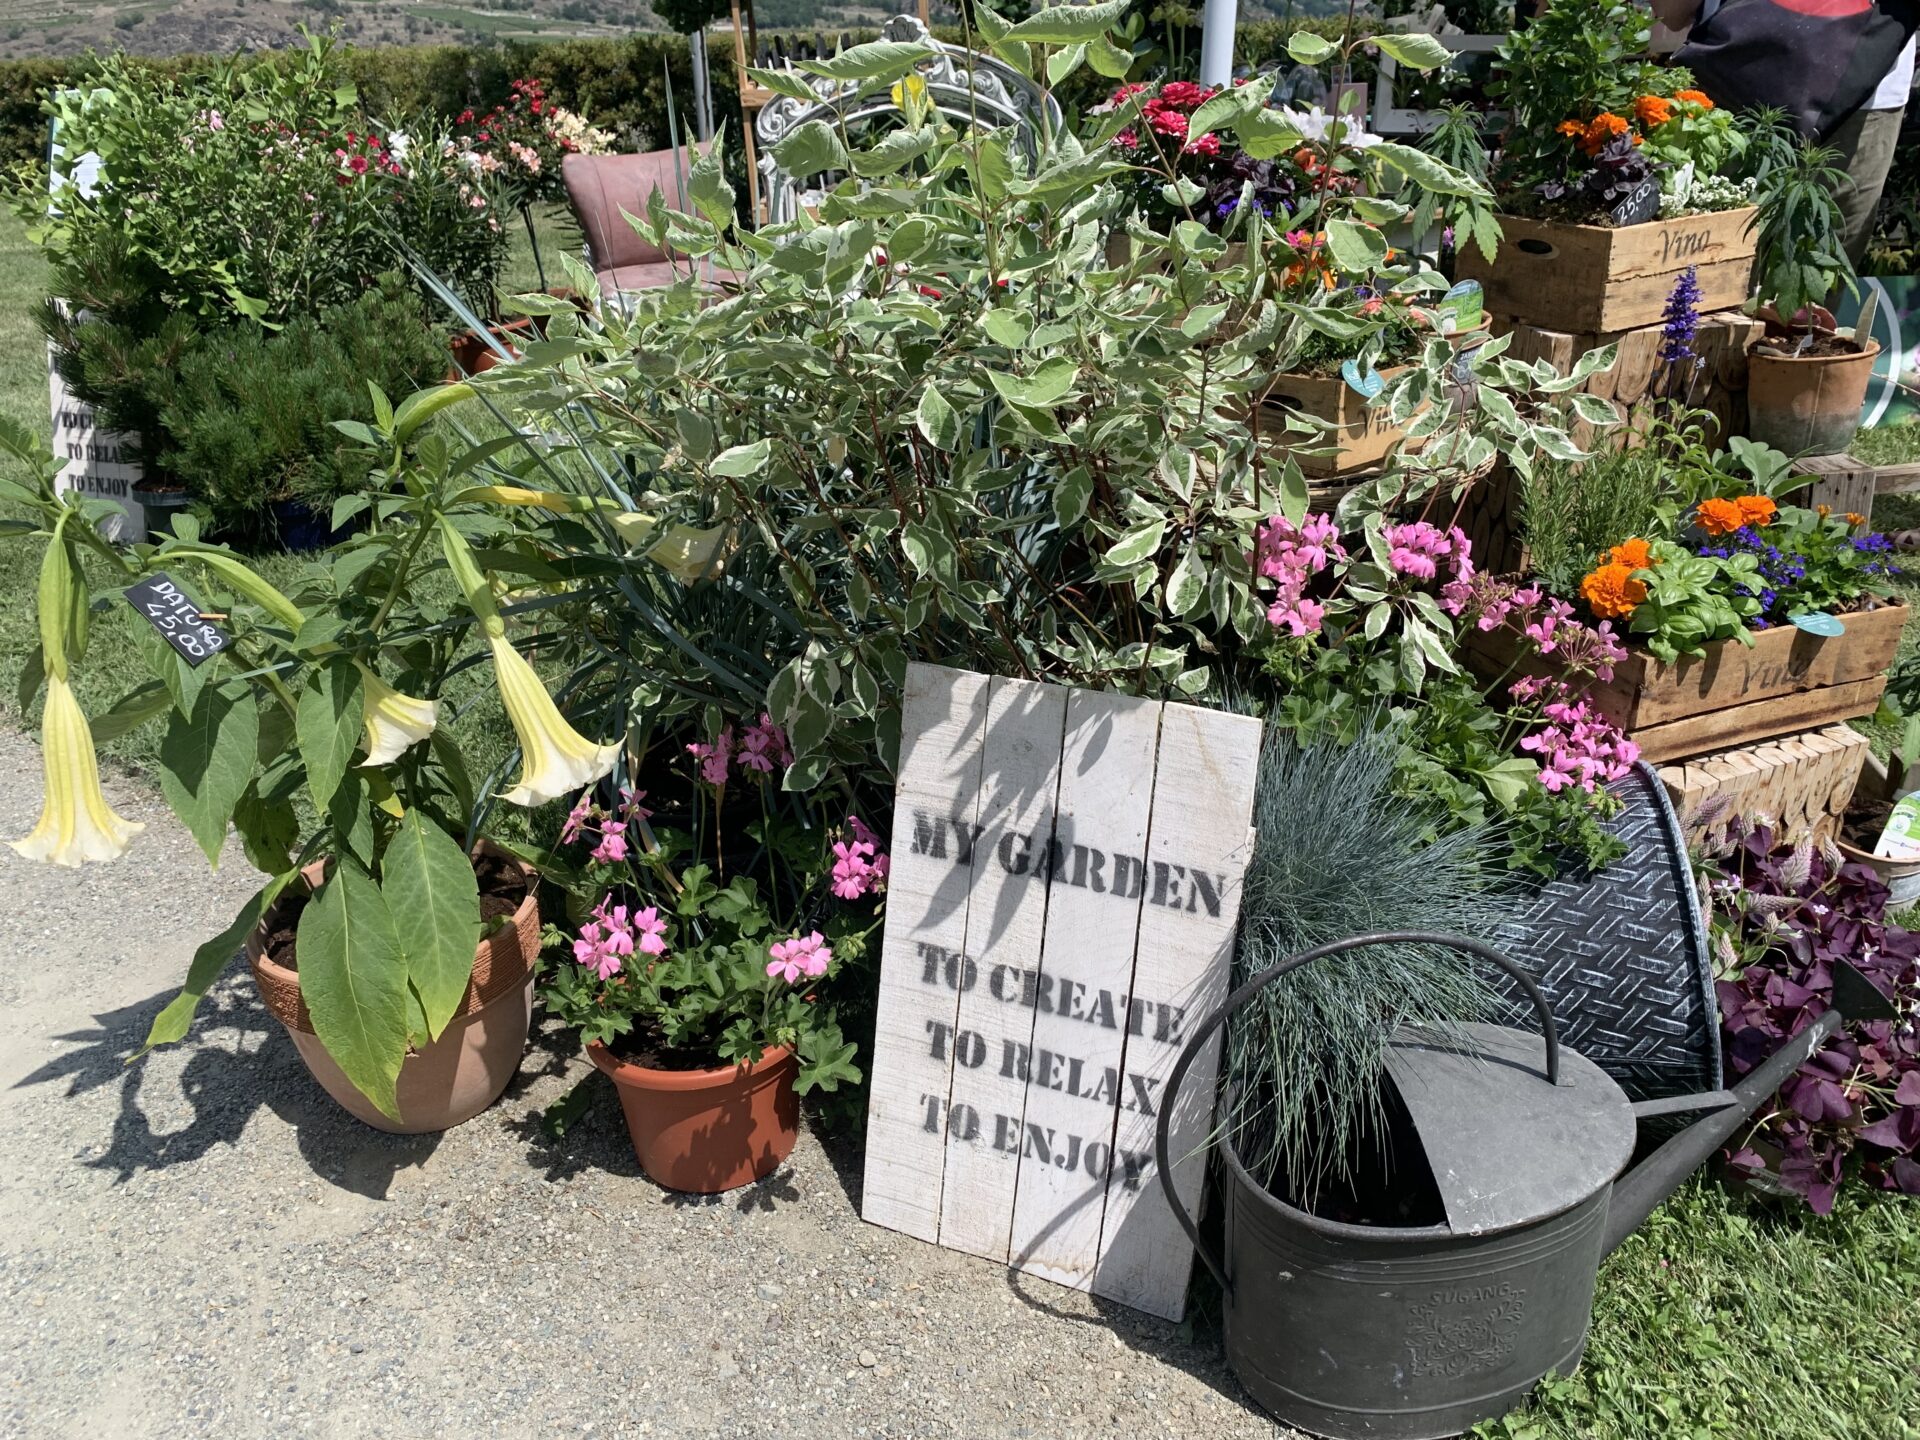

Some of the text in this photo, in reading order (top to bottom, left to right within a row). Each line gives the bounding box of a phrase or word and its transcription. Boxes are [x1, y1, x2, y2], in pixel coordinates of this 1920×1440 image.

[1617, 183, 1651, 221] 25,00
[1658, 229, 1711, 264] Vino
[66, 442, 119, 463] TO RELA
[69, 474, 129, 498] TO ENJOY
[146, 603, 205, 656] 45,00
[149, 581, 223, 649] DATURA
[910, 808, 1227, 918] MY GARDEN
[917, 941, 1185, 1046] TO CREATE
[926, 1019, 1161, 1117] TO RELAX
[919, 1092, 1154, 1191] TO ENJOY
